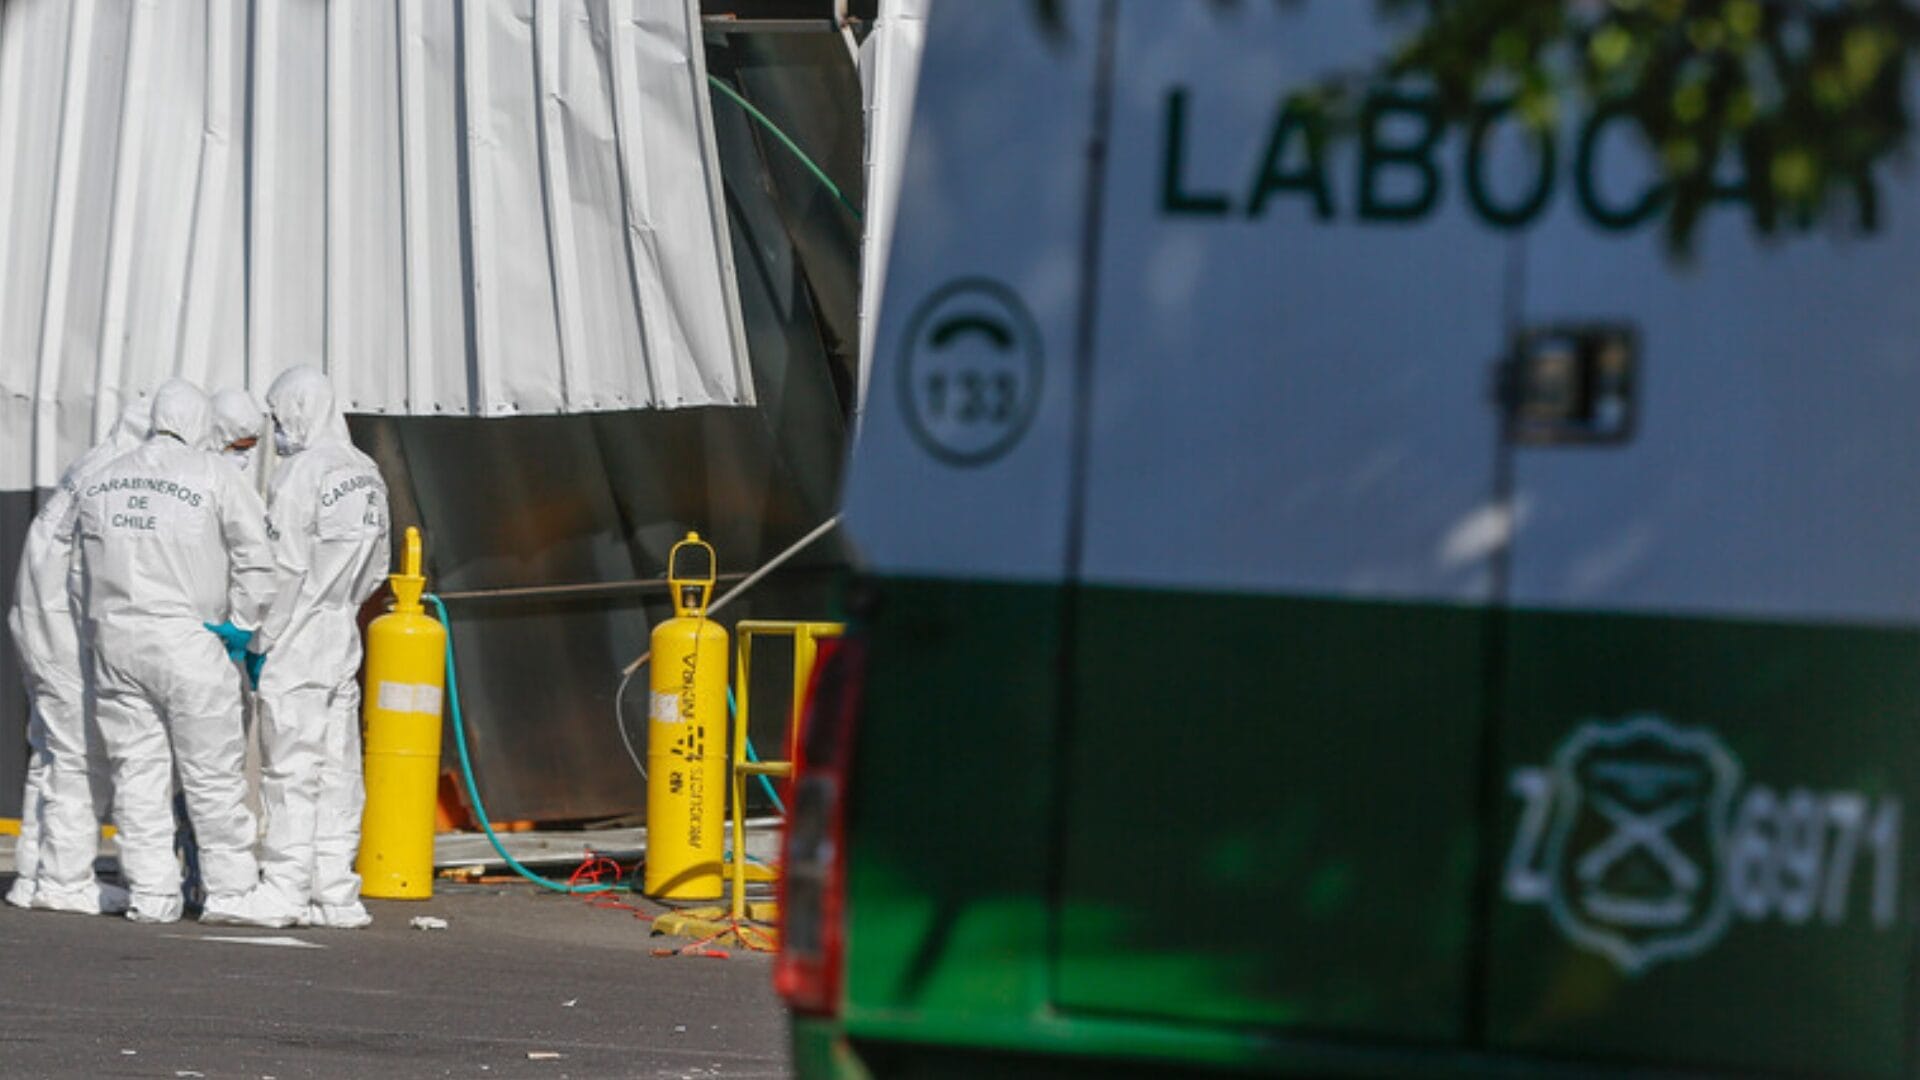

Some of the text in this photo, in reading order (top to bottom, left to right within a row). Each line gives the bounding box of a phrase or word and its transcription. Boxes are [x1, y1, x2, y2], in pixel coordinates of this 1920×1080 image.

[928, 367, 1017, 425] 133
[86, 478, 203, 507] CARABINEROS
[127, 496, 149, 509] DE
[112, 513, 157, 530] CHILE
[1730, 787, 1900, 927] 6971
